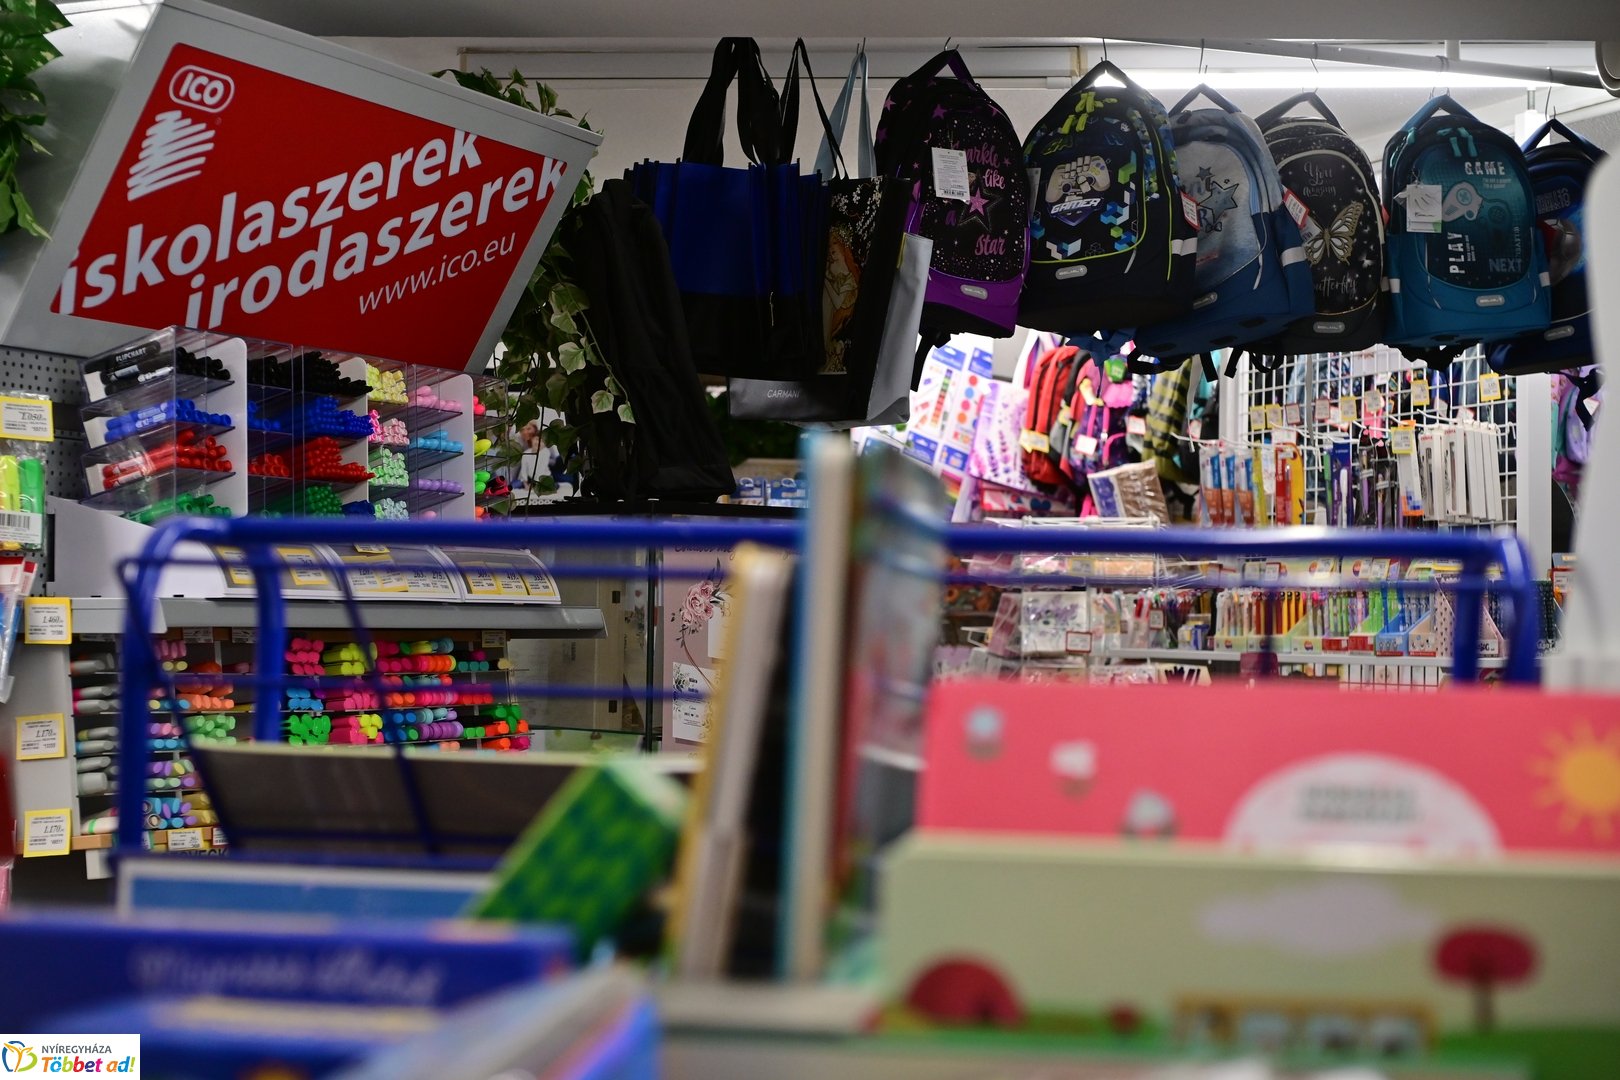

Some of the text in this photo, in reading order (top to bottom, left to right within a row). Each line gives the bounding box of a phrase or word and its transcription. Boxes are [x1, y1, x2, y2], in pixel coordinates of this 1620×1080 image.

[178, 75, 224, 107] ICO
[983, 168, 1005, 189] like
[1464, 161, 1506, 176] GAME
[1050, 197, 1102, 215] GAMER
[58, 129, 484, 316] iskolaszerek
[184, 157, 567, 330] irodaszerek
[1447, 231, 1465, 274] PLAY
[358, 231, 516, 315] www.ico.eu
[1488, 258, 1522, 273] NEXT
[1313, 271, 1357, 299] utterfly
[115, 347, 147, 362] FLIPCHART
